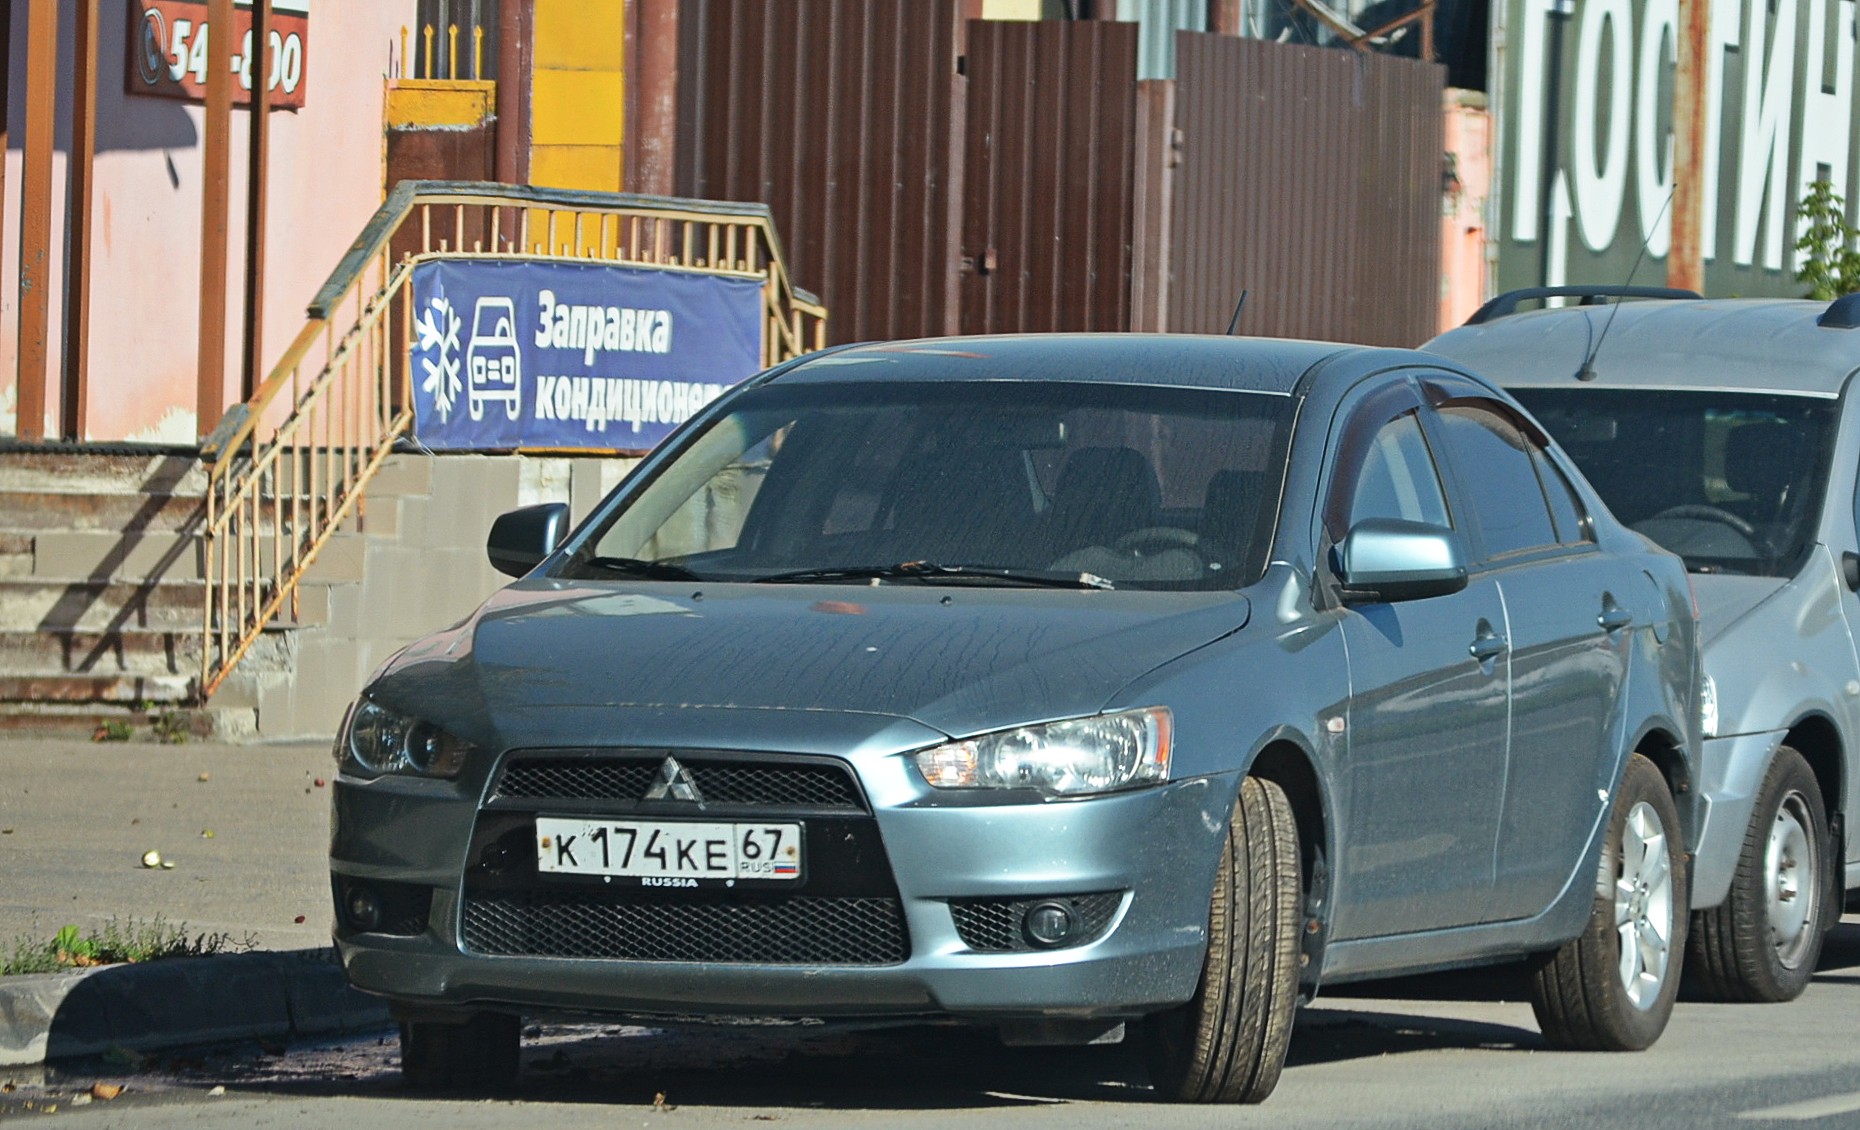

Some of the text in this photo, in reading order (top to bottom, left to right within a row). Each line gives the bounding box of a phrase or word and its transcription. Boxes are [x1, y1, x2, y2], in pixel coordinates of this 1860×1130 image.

[168, 18, 303, 95] 54-800
[1512, 0, 1860, 279] ГОСТИН
[535, 289, 672, 367] Заправка
[535, 375, 734, 433] кондиционе
[740, 861, 771, 873] RUS
[742, 829, 782, 860] 67
[641, 876, 698, 888] RUSSIA
